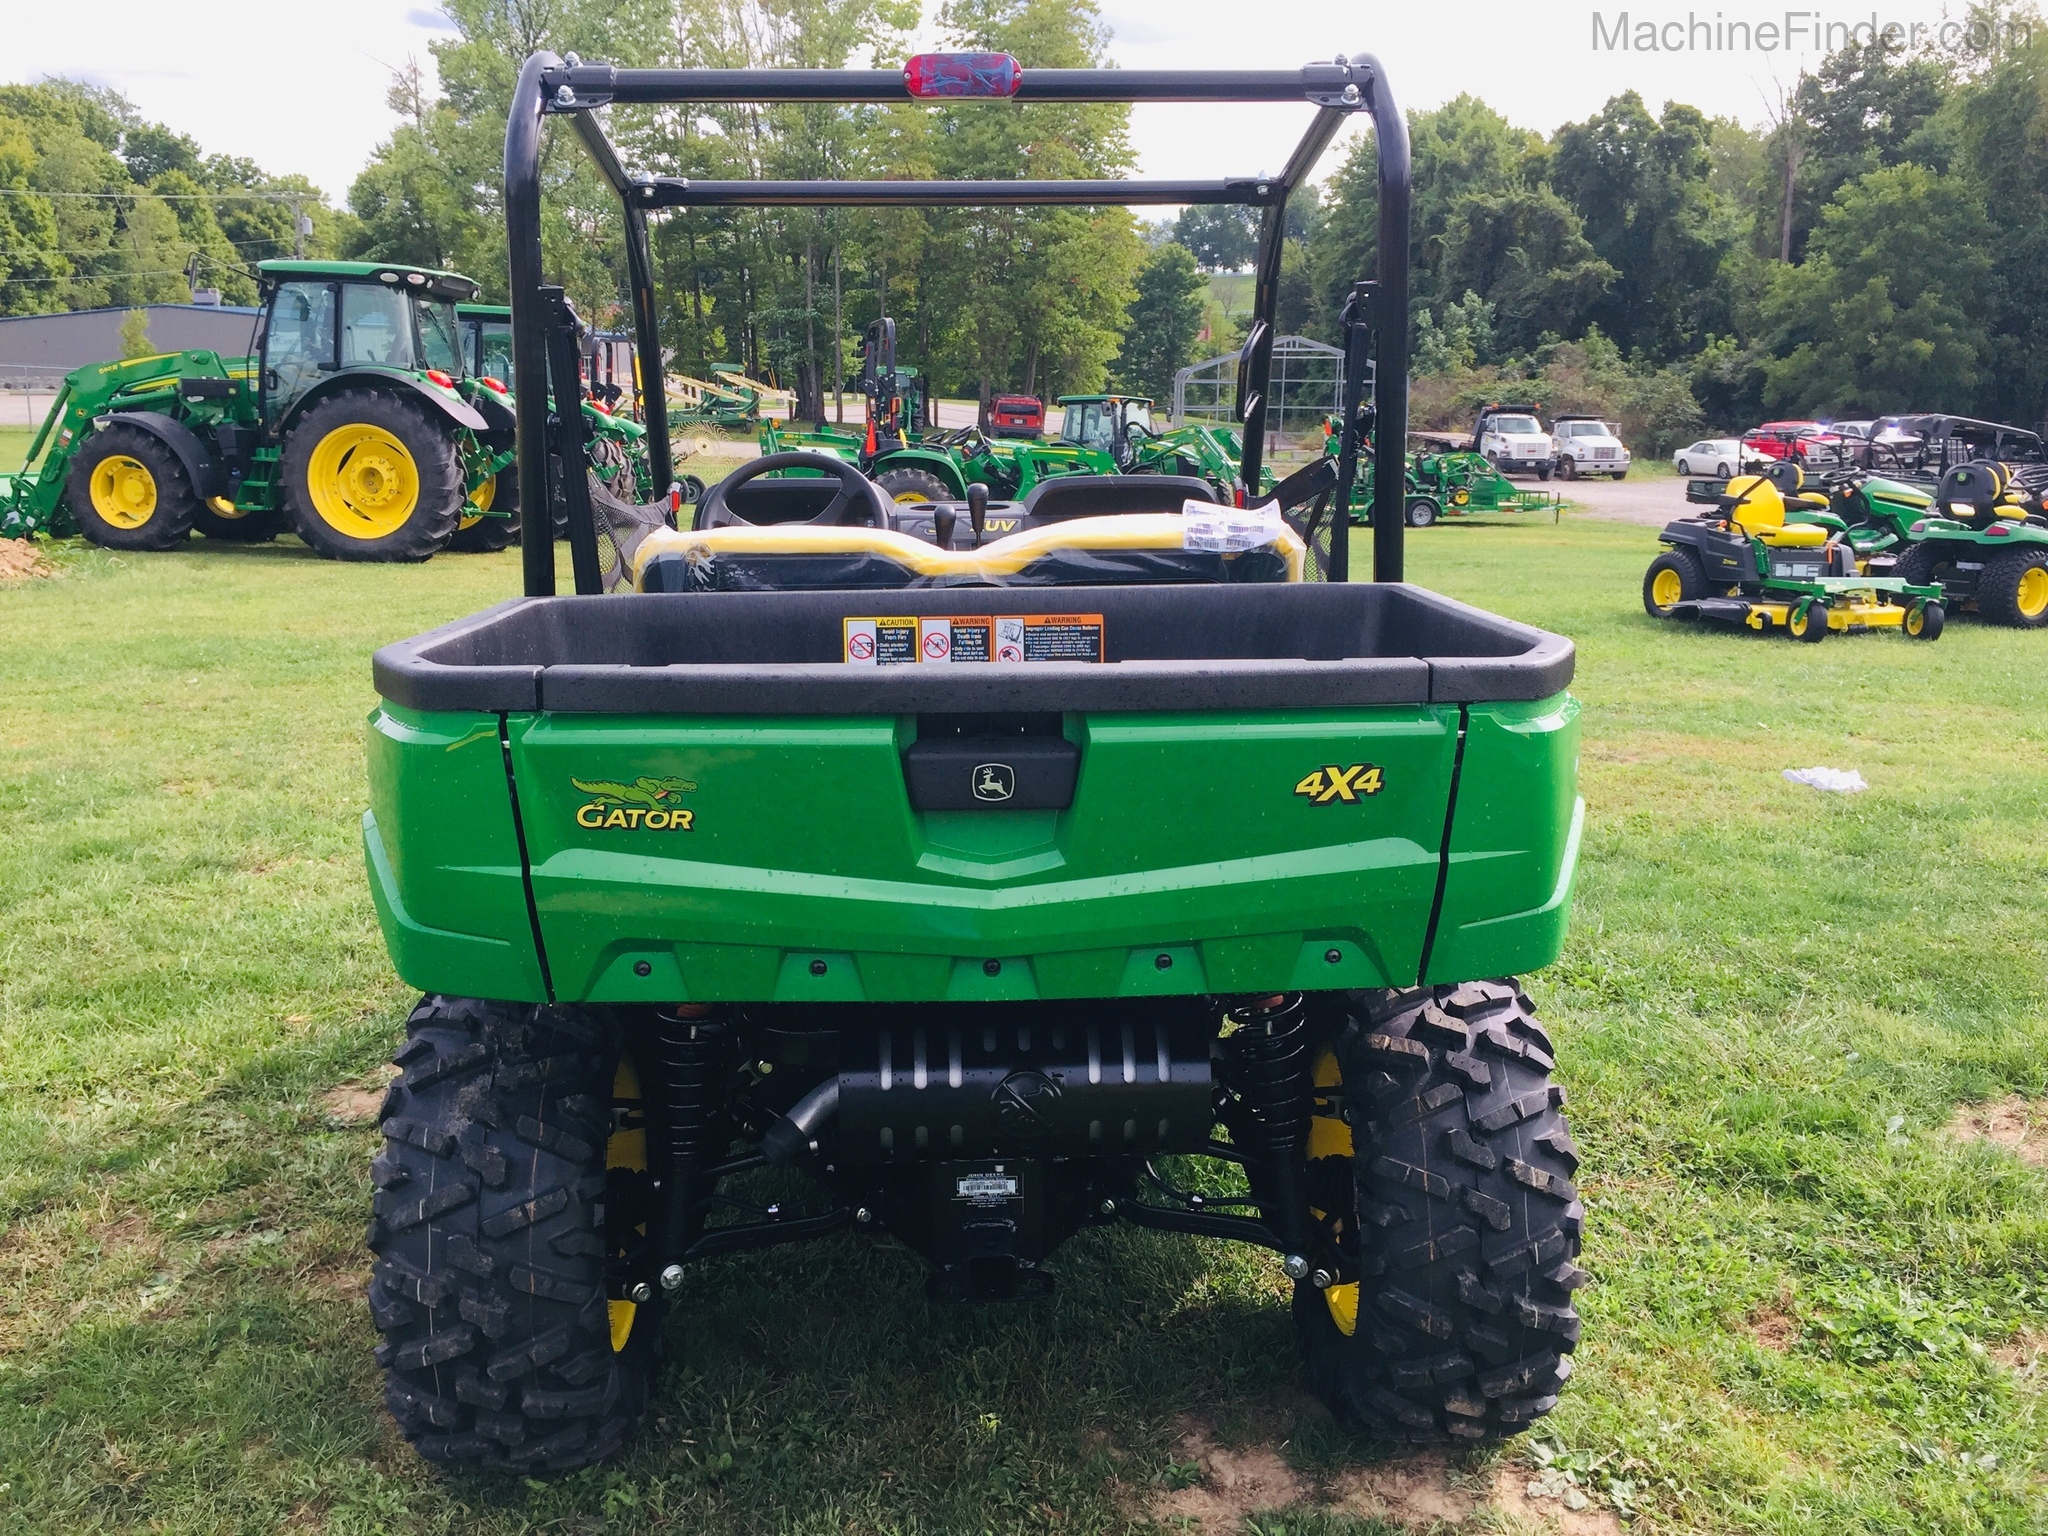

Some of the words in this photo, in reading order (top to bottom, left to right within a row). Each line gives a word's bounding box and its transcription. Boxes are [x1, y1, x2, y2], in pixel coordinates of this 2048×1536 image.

[886, 618, 914, 626] CAUTION
[958, 617, 990, 625] WARNING
[1051, 616, 1082, 624] WARNING
[1294, 764, 1383, 803] 4X4
[576, 804, 695, 830] GATOR
